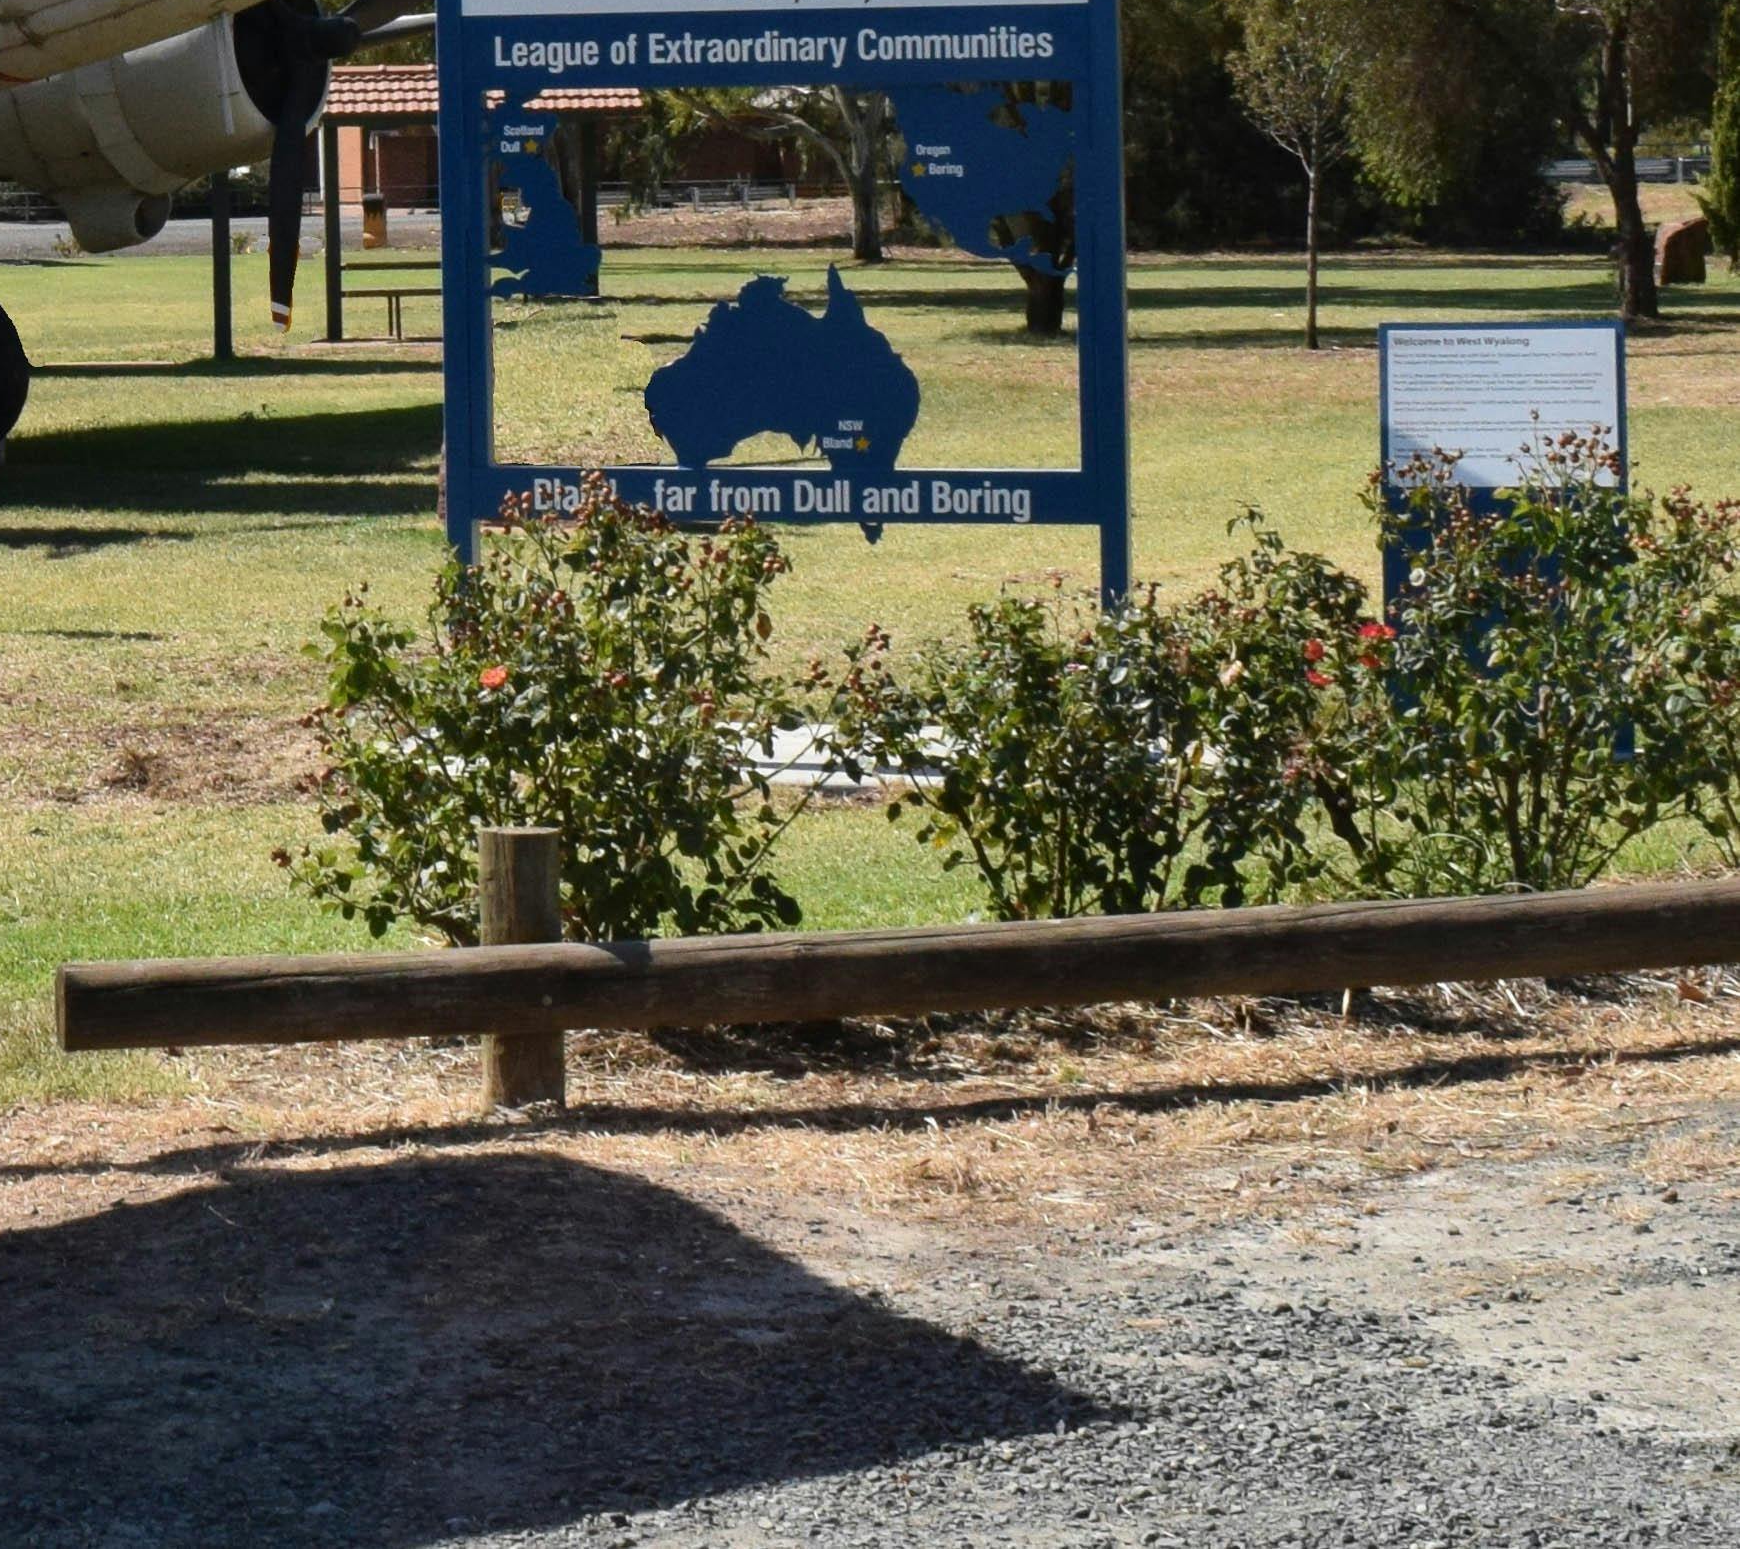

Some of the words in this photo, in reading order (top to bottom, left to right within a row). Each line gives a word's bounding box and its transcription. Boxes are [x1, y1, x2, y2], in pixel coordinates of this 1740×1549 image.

[494, 36, 599, 74] League
[610, 32, 637, 65] of
[648, 30, 847, 68] Extraordinary
[857, 26, 1053, 62] Communities
[503, 124, 544, 136] Scotland
[500, 140, 520, 153] Dull
[916, 144, 951, 158] Oregon
[928, 162, 963, 178] Boring
[838, 420, 863, 431] NSW
[822, 436, 853, 449] Bland
[653, 478, 697, 512] far
[709, 478, 780, 513] from
[794, 479, 850, 513] Dull
[862, 480, 919, 514] and
[931, 480, 1031, 523] Boring
